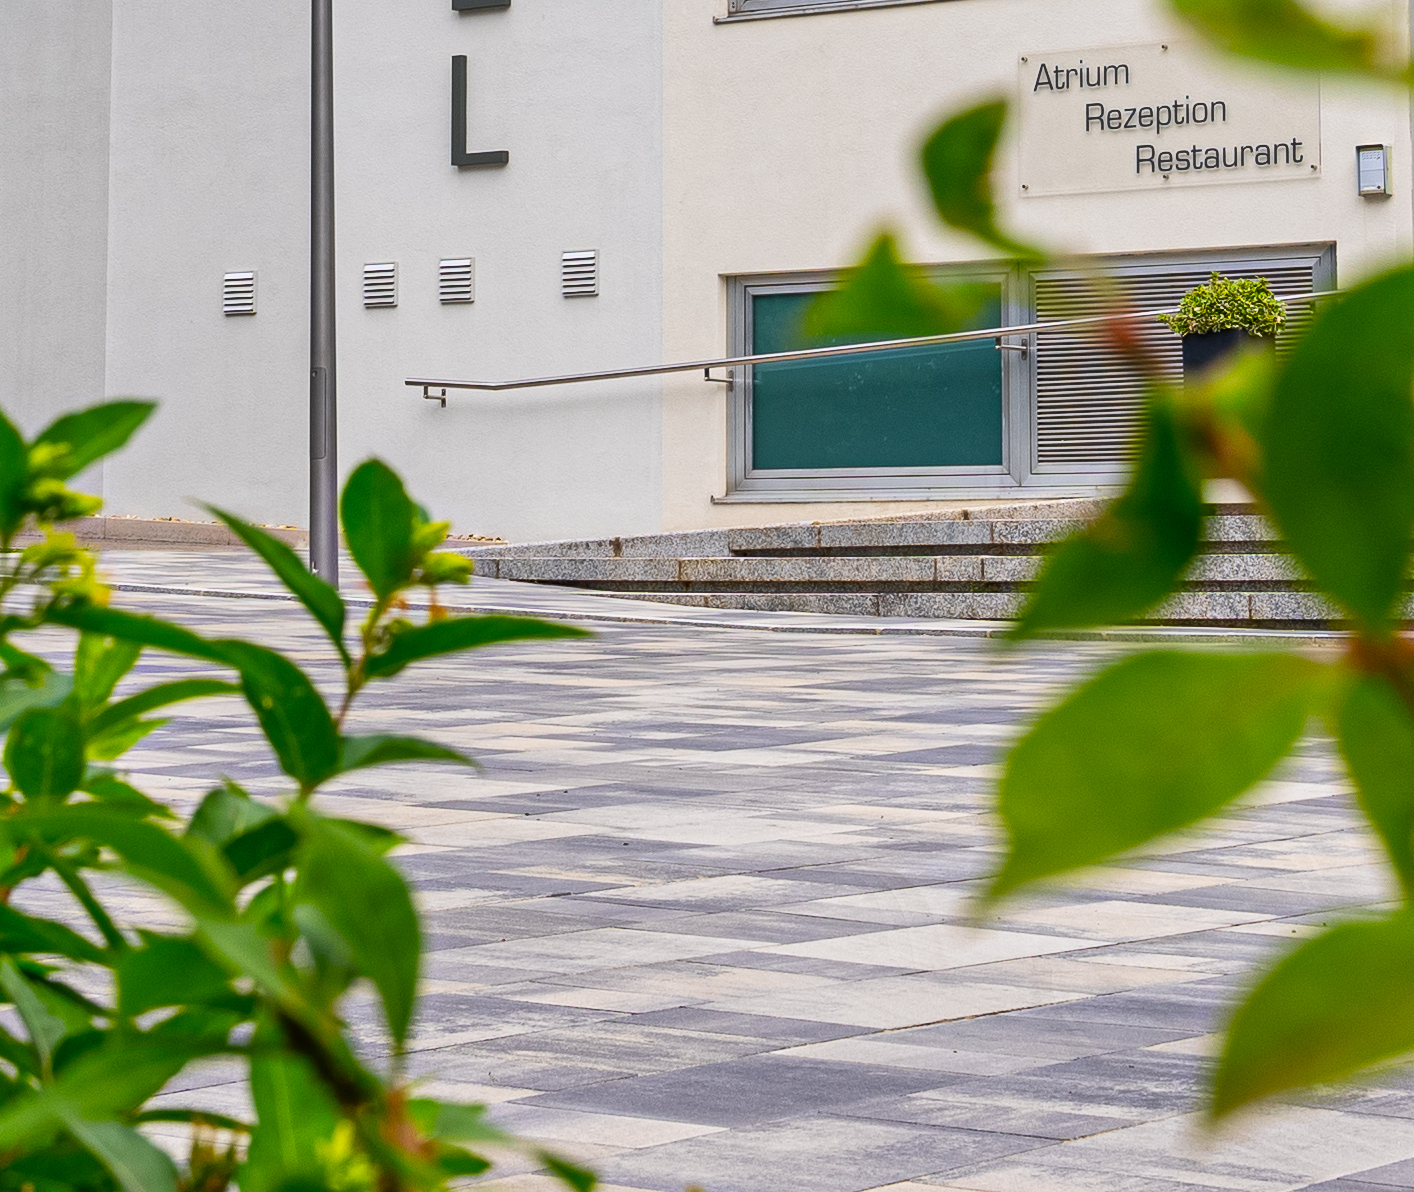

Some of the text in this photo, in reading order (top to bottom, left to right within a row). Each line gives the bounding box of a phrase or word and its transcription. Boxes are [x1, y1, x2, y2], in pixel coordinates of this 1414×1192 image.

[1033, 59, 1130, 93] Atrium
[1085, 95, 1227, 134] Rezeption
[1135, 137, 1304, 174] Restaurant
